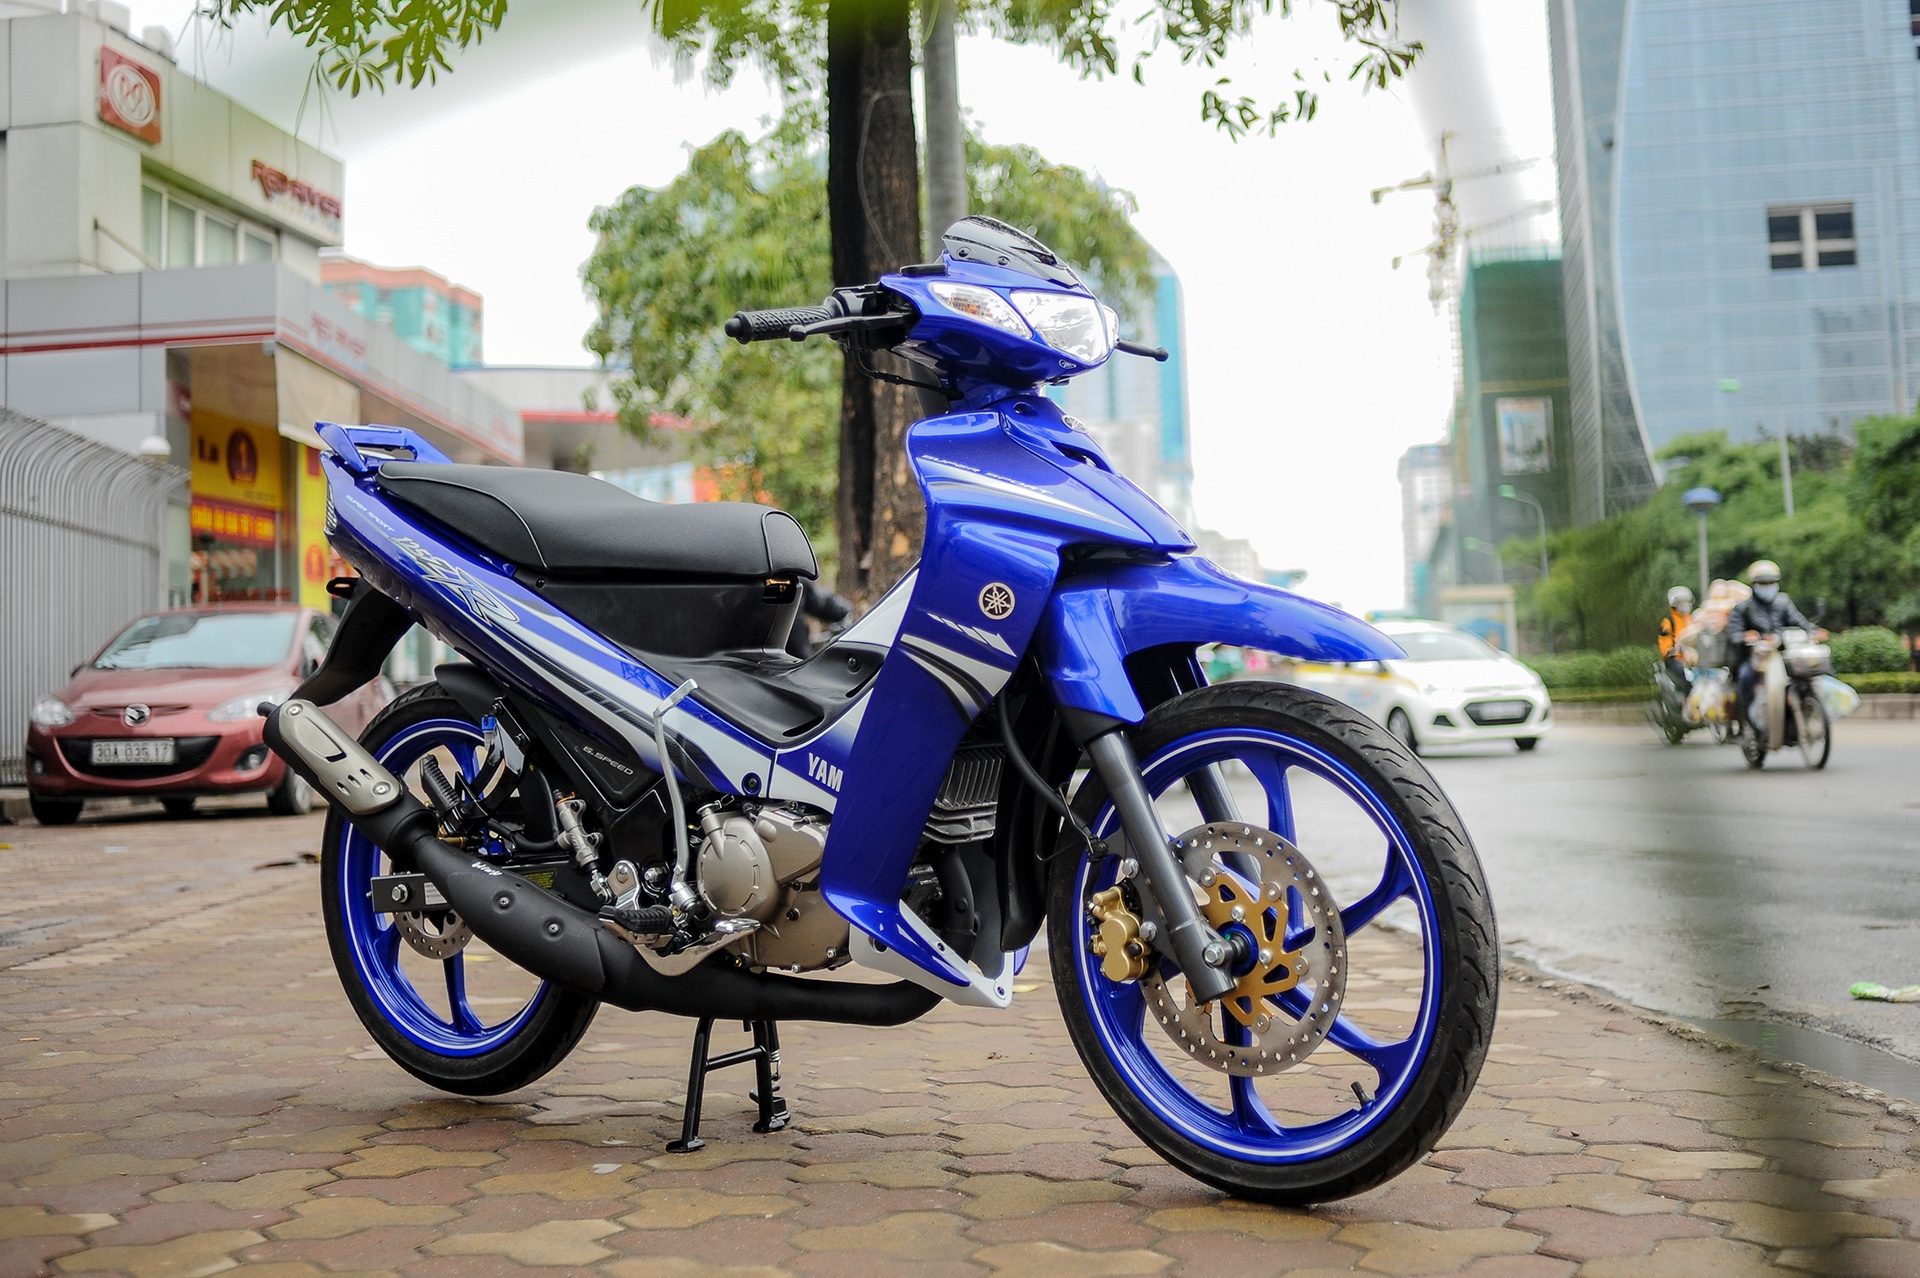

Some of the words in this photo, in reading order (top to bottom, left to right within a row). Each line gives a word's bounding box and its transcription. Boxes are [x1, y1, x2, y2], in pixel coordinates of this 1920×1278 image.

[921, 453, 981, 473] SUPER
[984, 471, 1055, 495] SPORT
[345, 494, 369, 512] SUPER
[367, 511, 396, 532] SPORT
